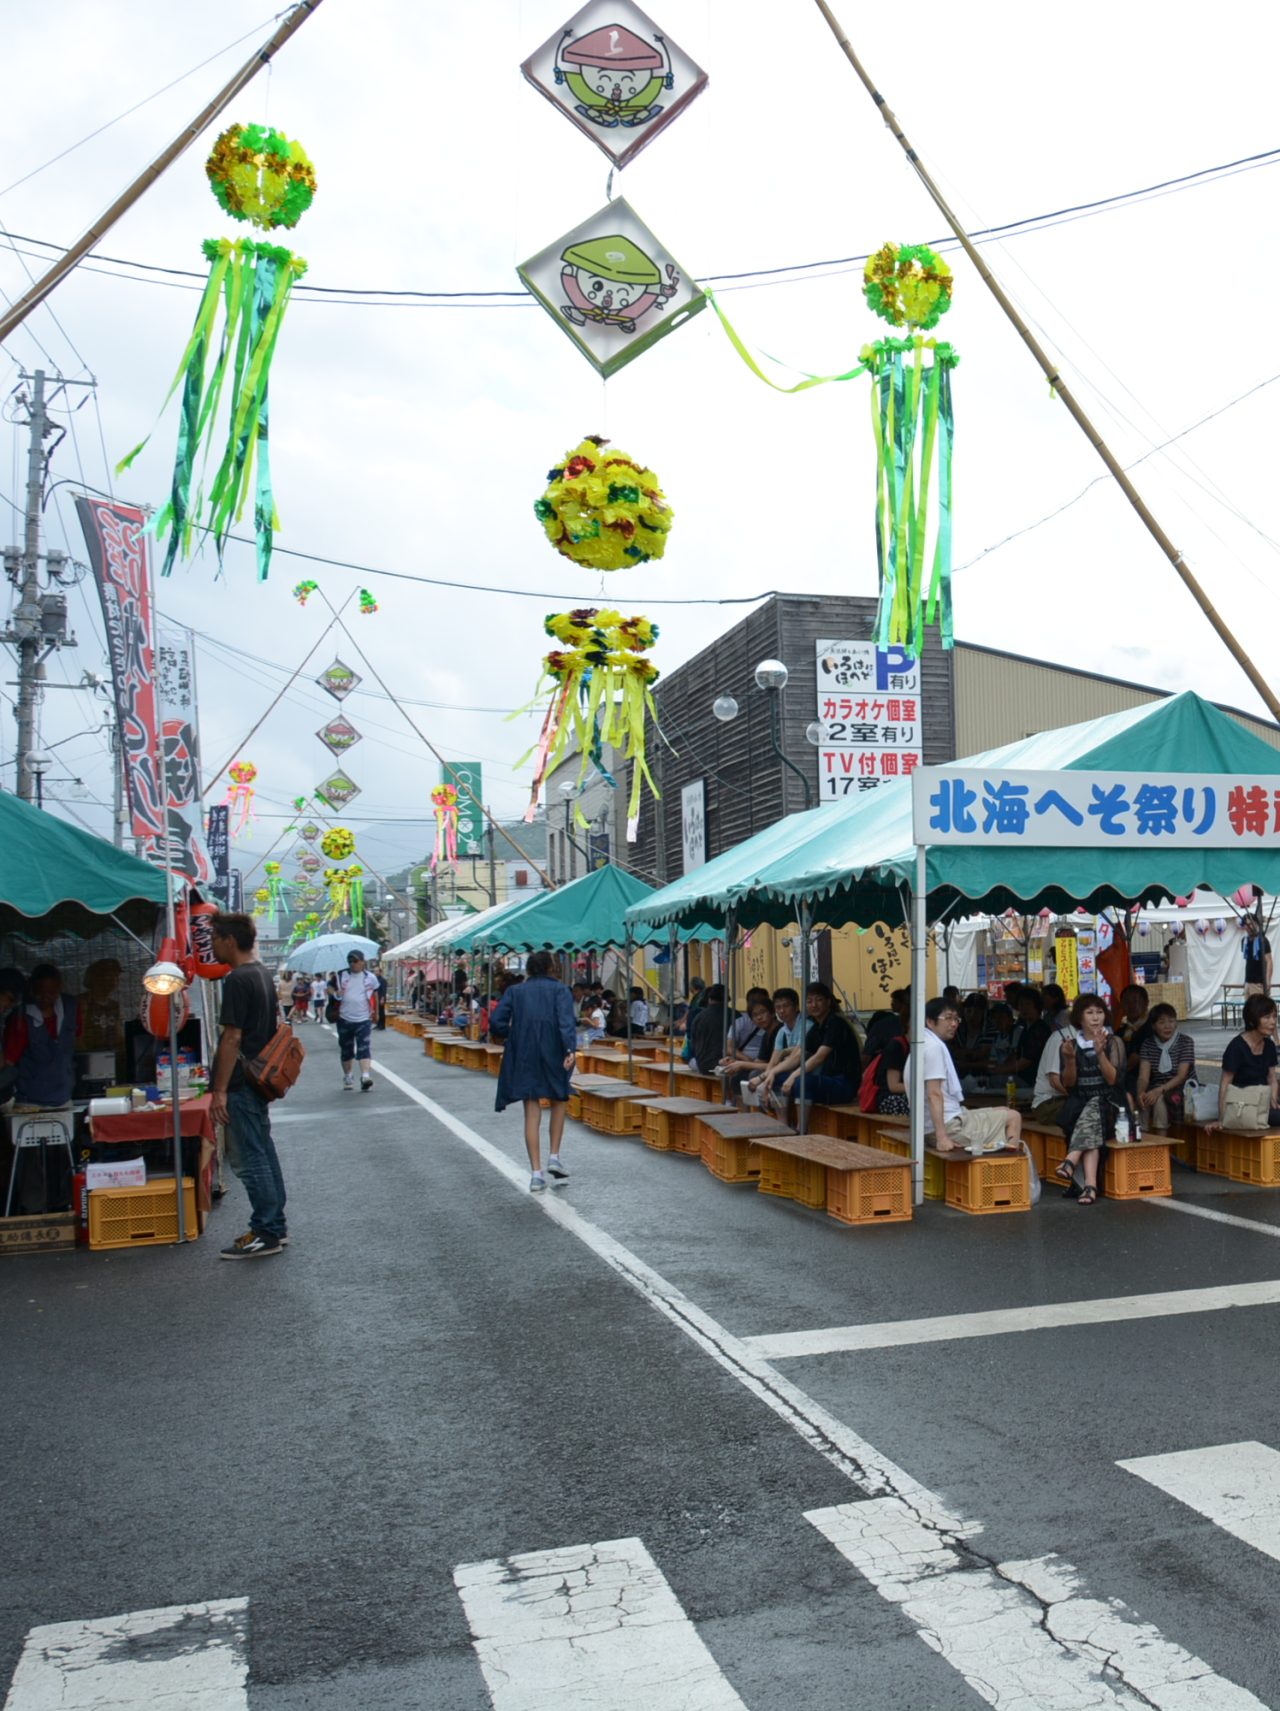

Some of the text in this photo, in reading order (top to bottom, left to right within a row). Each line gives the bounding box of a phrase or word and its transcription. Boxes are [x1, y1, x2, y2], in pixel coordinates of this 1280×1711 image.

[875, 645, 916, 691] P 有り
[823, 698, 917, 721] カラオケ個室
[828, 723, 914, 743] 2室有り
[823, 752, 919, 776] TV付個室
[929, 778, 1217, 837] 北海へそ祭り
